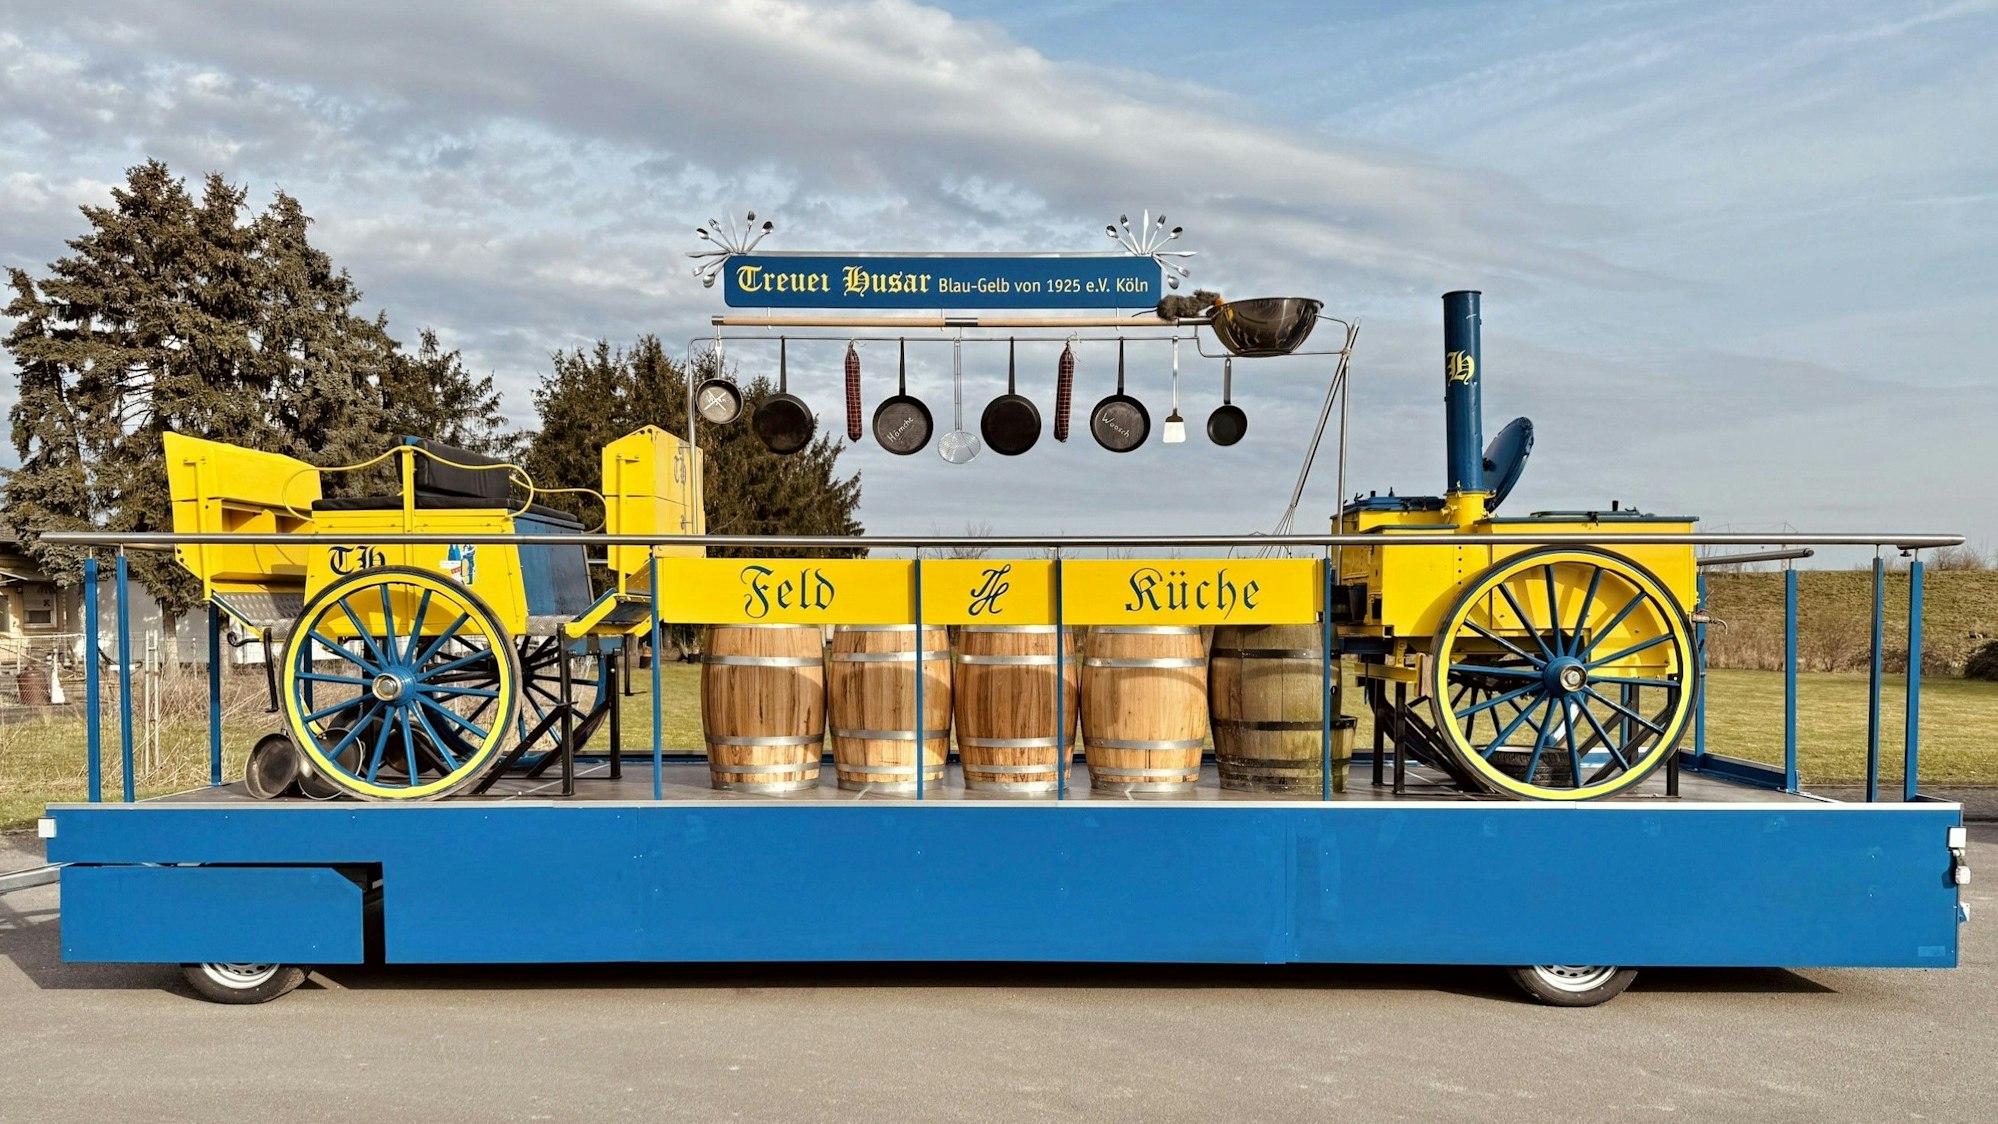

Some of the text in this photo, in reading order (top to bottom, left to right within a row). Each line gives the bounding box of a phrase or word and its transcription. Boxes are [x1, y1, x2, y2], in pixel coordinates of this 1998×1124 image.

[842, 265, 932, 298] Husar
[938, 277, 1010, 293] Blau-Gelb
[1014, 280, 1041, 293] von
[1046, 278, 1081, 293] 1925
[1085, 277, 1110, 293] e.V.
[1116, 277, 1149, 293] Köln
[740, 565, 835, 618] Feld
[1125, 567, 1260, 620] Küche
